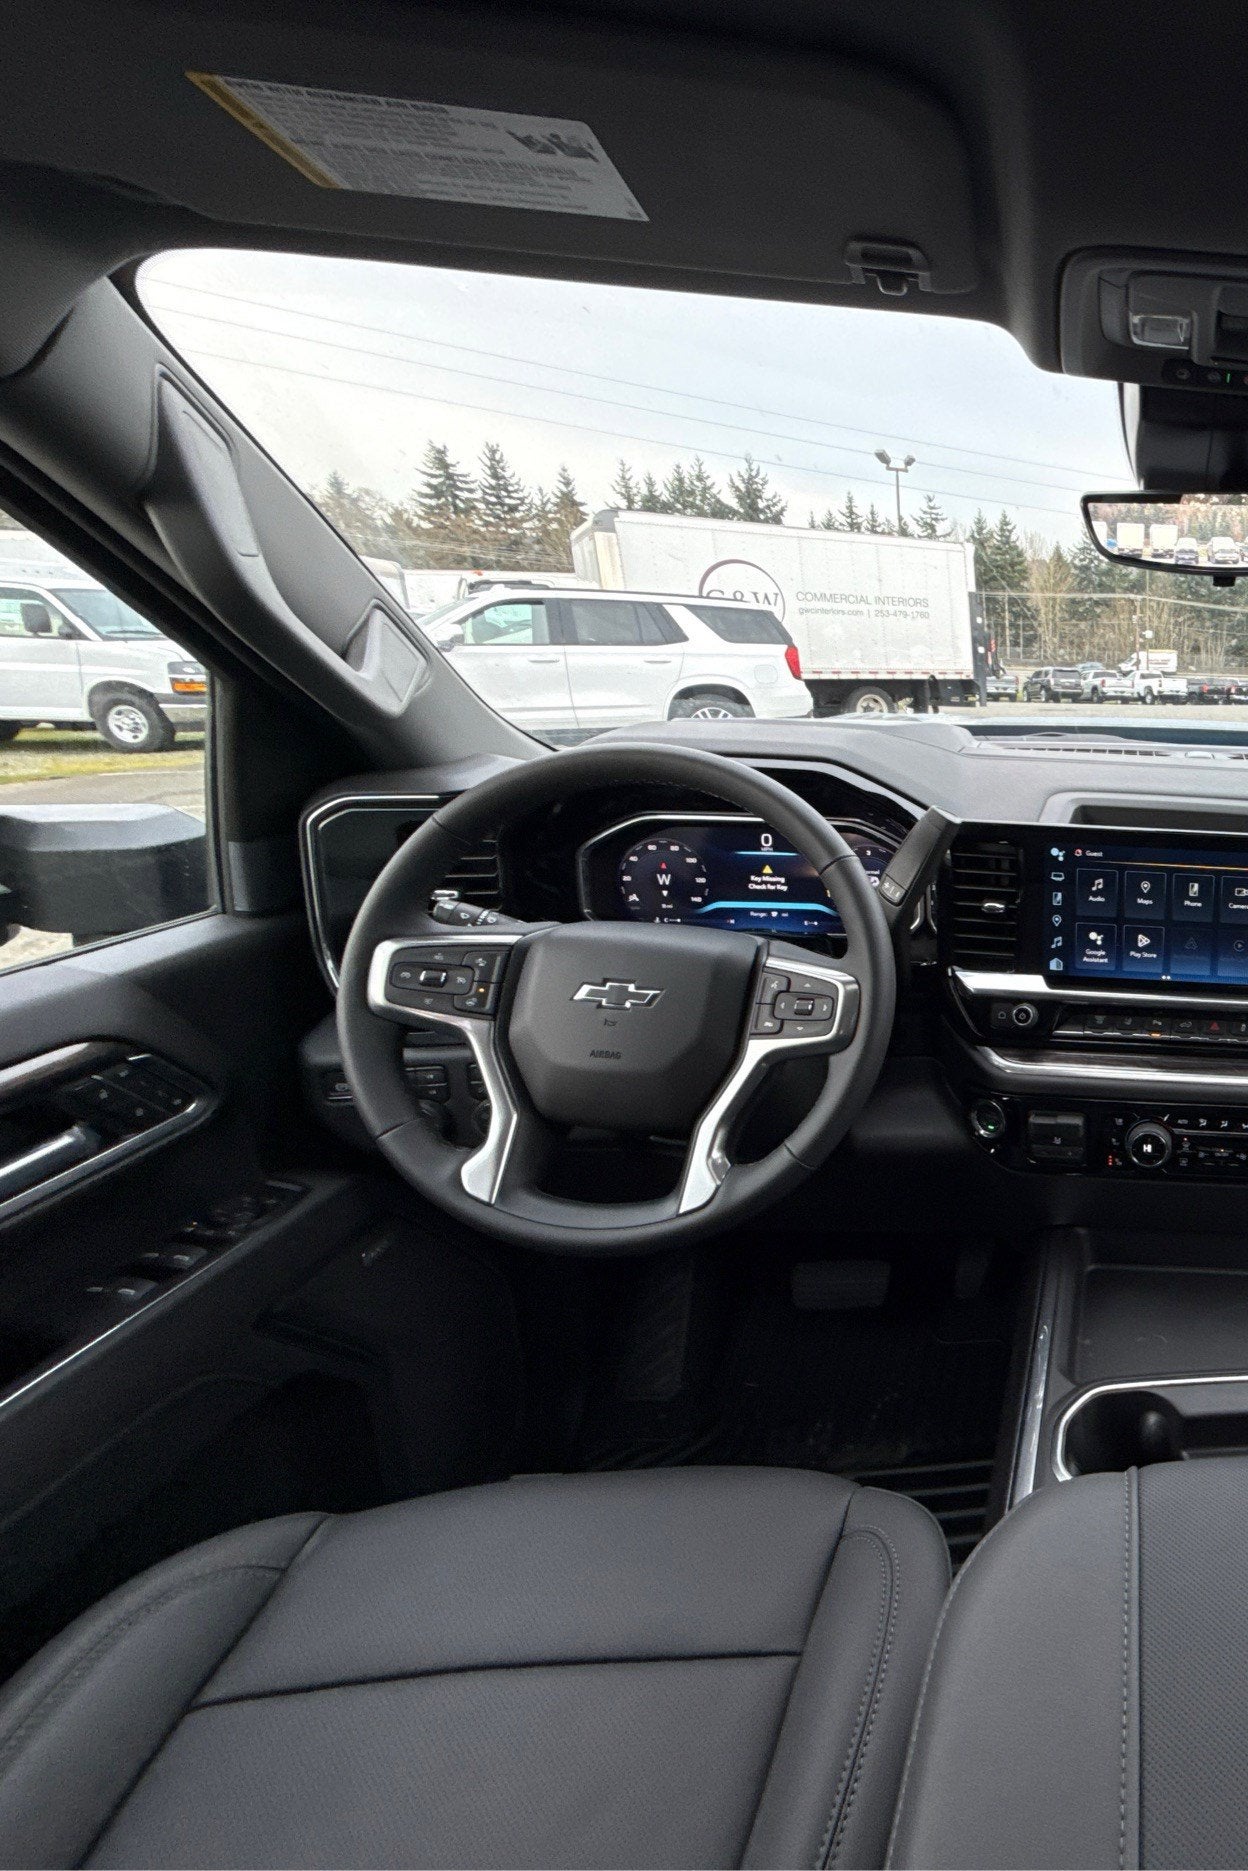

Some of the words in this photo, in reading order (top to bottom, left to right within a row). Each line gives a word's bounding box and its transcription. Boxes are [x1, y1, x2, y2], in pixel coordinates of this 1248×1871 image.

[796, 591, 872, 605] COMMERCIAL
[874, 596, 930, 608] INTERIORS
[798, 607, 864, 616] gwcinteriors.com
[874, 609, 930, 619] 253-479-1760
[761, 833, 773, 847] 0
[1085, 850, 1103, 858] Guest
[656, 873, 672, 886] W
[750, 875, 762, 883] Key
[762, 876, 786, 884] Missing
[776, 884, 788, 892] Key
[1137, 898, 1154, 906] Maps
[1184, 900, 1202, 908] Phone
[1085, 949, 1106, 957] Google
[1129, 951, 1142, 959] Play
[590, 1050, 622, 1059] AIRBAG
[1143, 1144, 1152, 1153] HI
